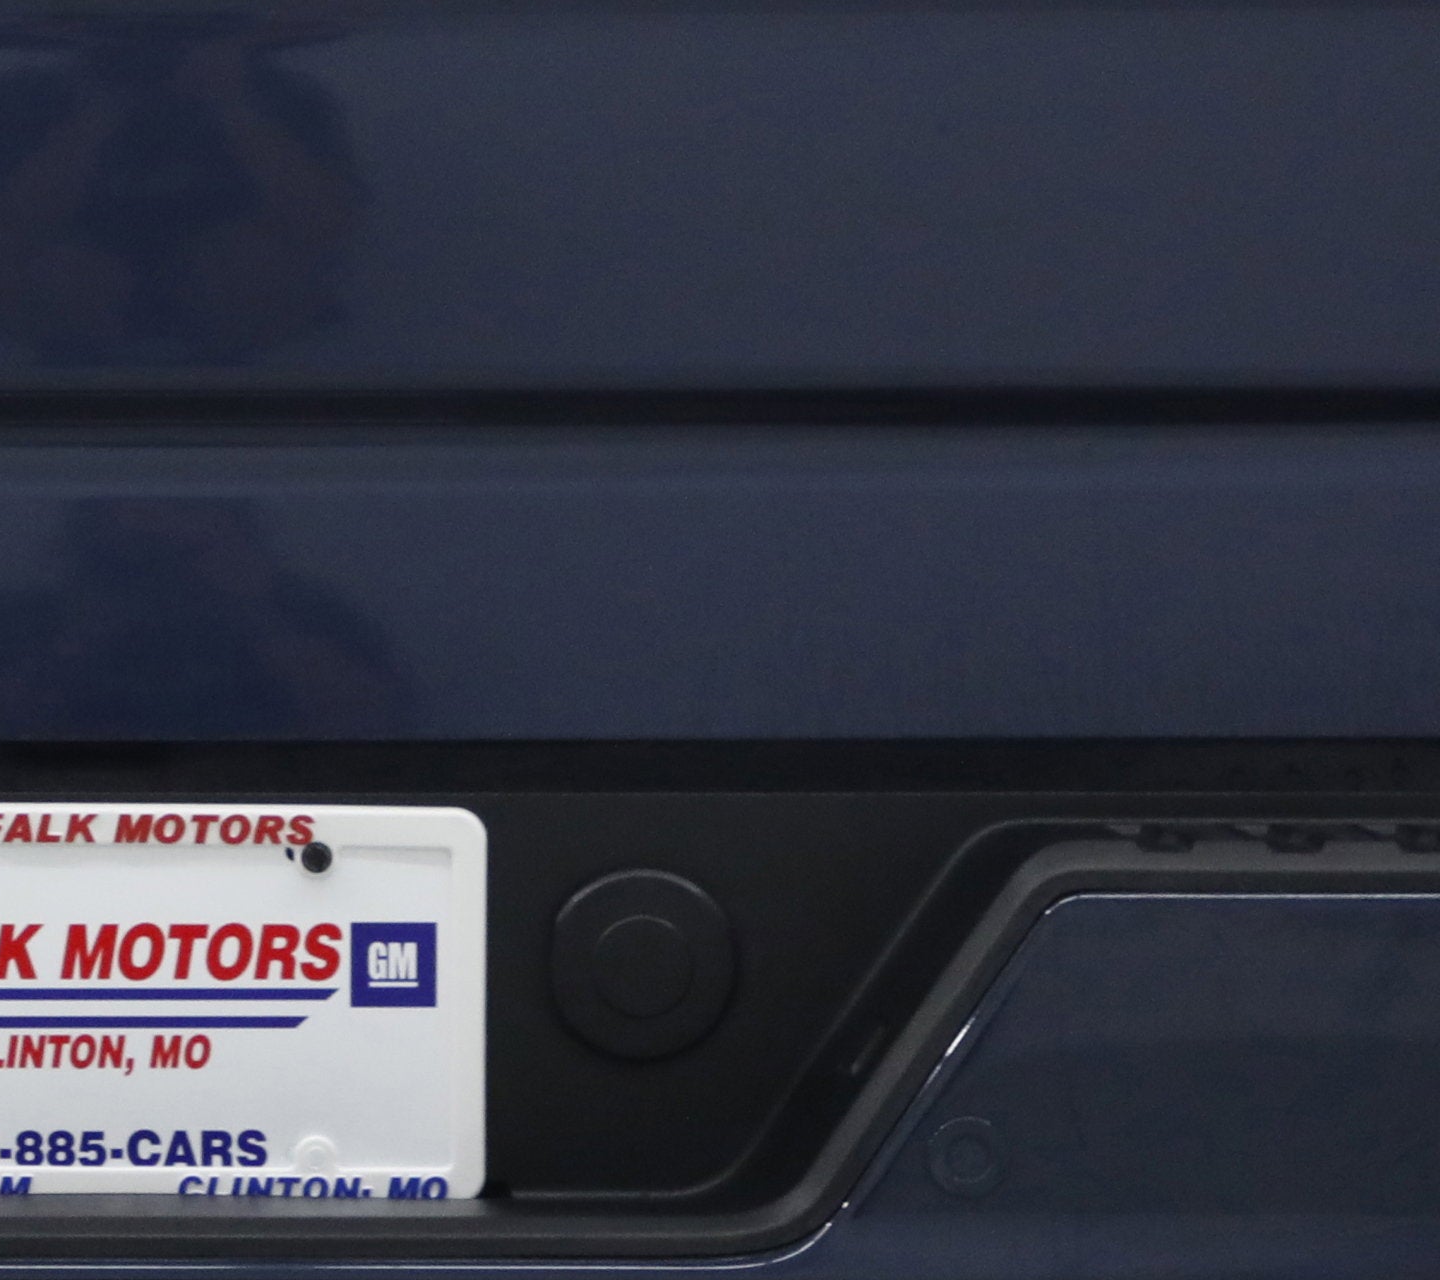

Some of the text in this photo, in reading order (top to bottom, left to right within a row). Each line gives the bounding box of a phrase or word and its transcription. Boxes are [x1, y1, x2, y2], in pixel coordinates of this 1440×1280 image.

[114, 814, 316, 845] MOTORS
[59, 924, 341, 981] MOTORS
[367, 941, 418, 987] GM
[150, 1035, 211, 1070] MO
[387, 1176, 449, 1200] MO
